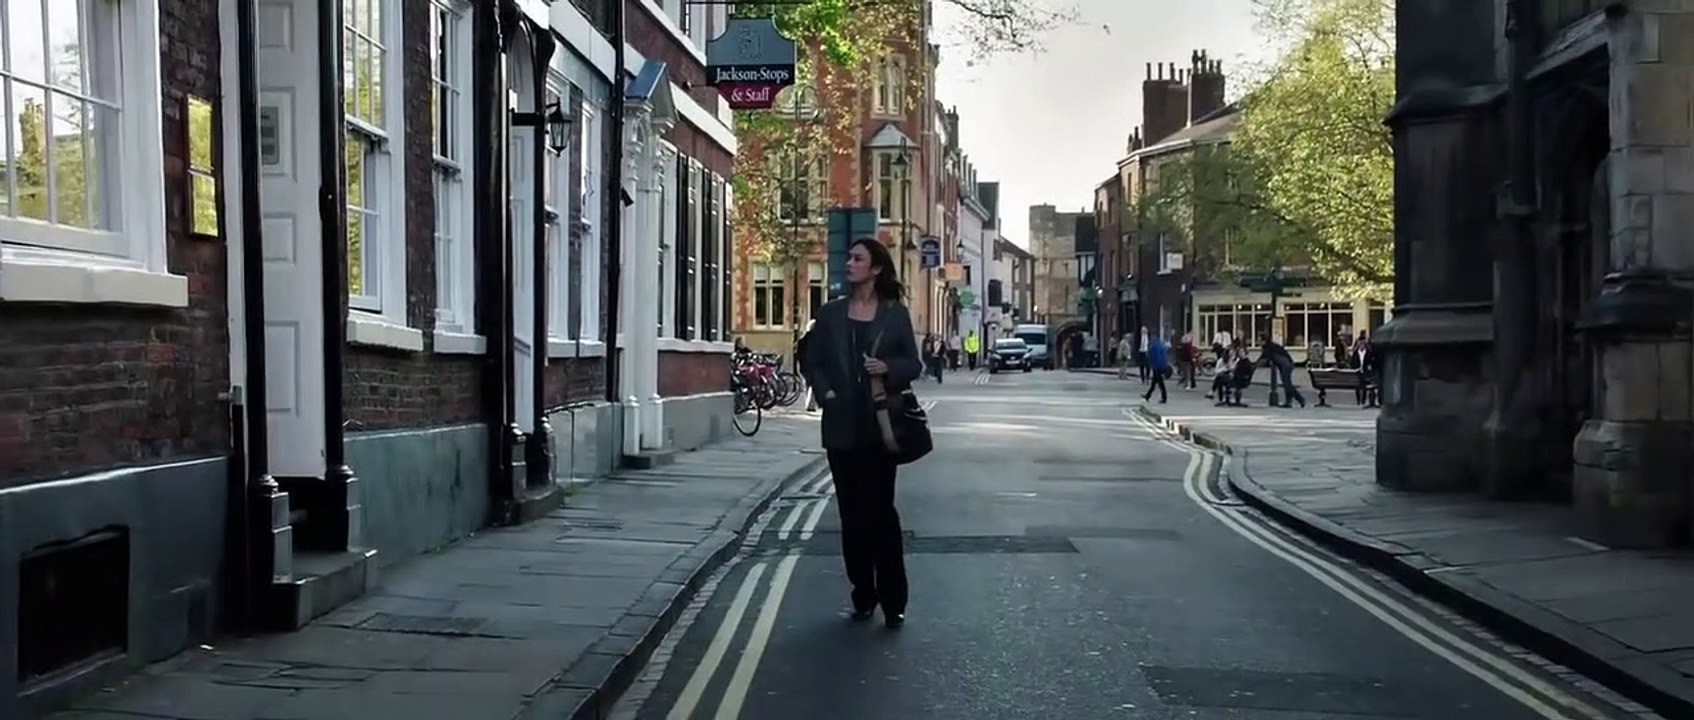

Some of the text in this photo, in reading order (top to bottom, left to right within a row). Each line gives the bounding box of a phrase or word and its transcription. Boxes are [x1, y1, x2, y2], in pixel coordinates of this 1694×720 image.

[715, 66, 789, 84] Jackson-Stops
[731, 87, 770, 102] & Staff
